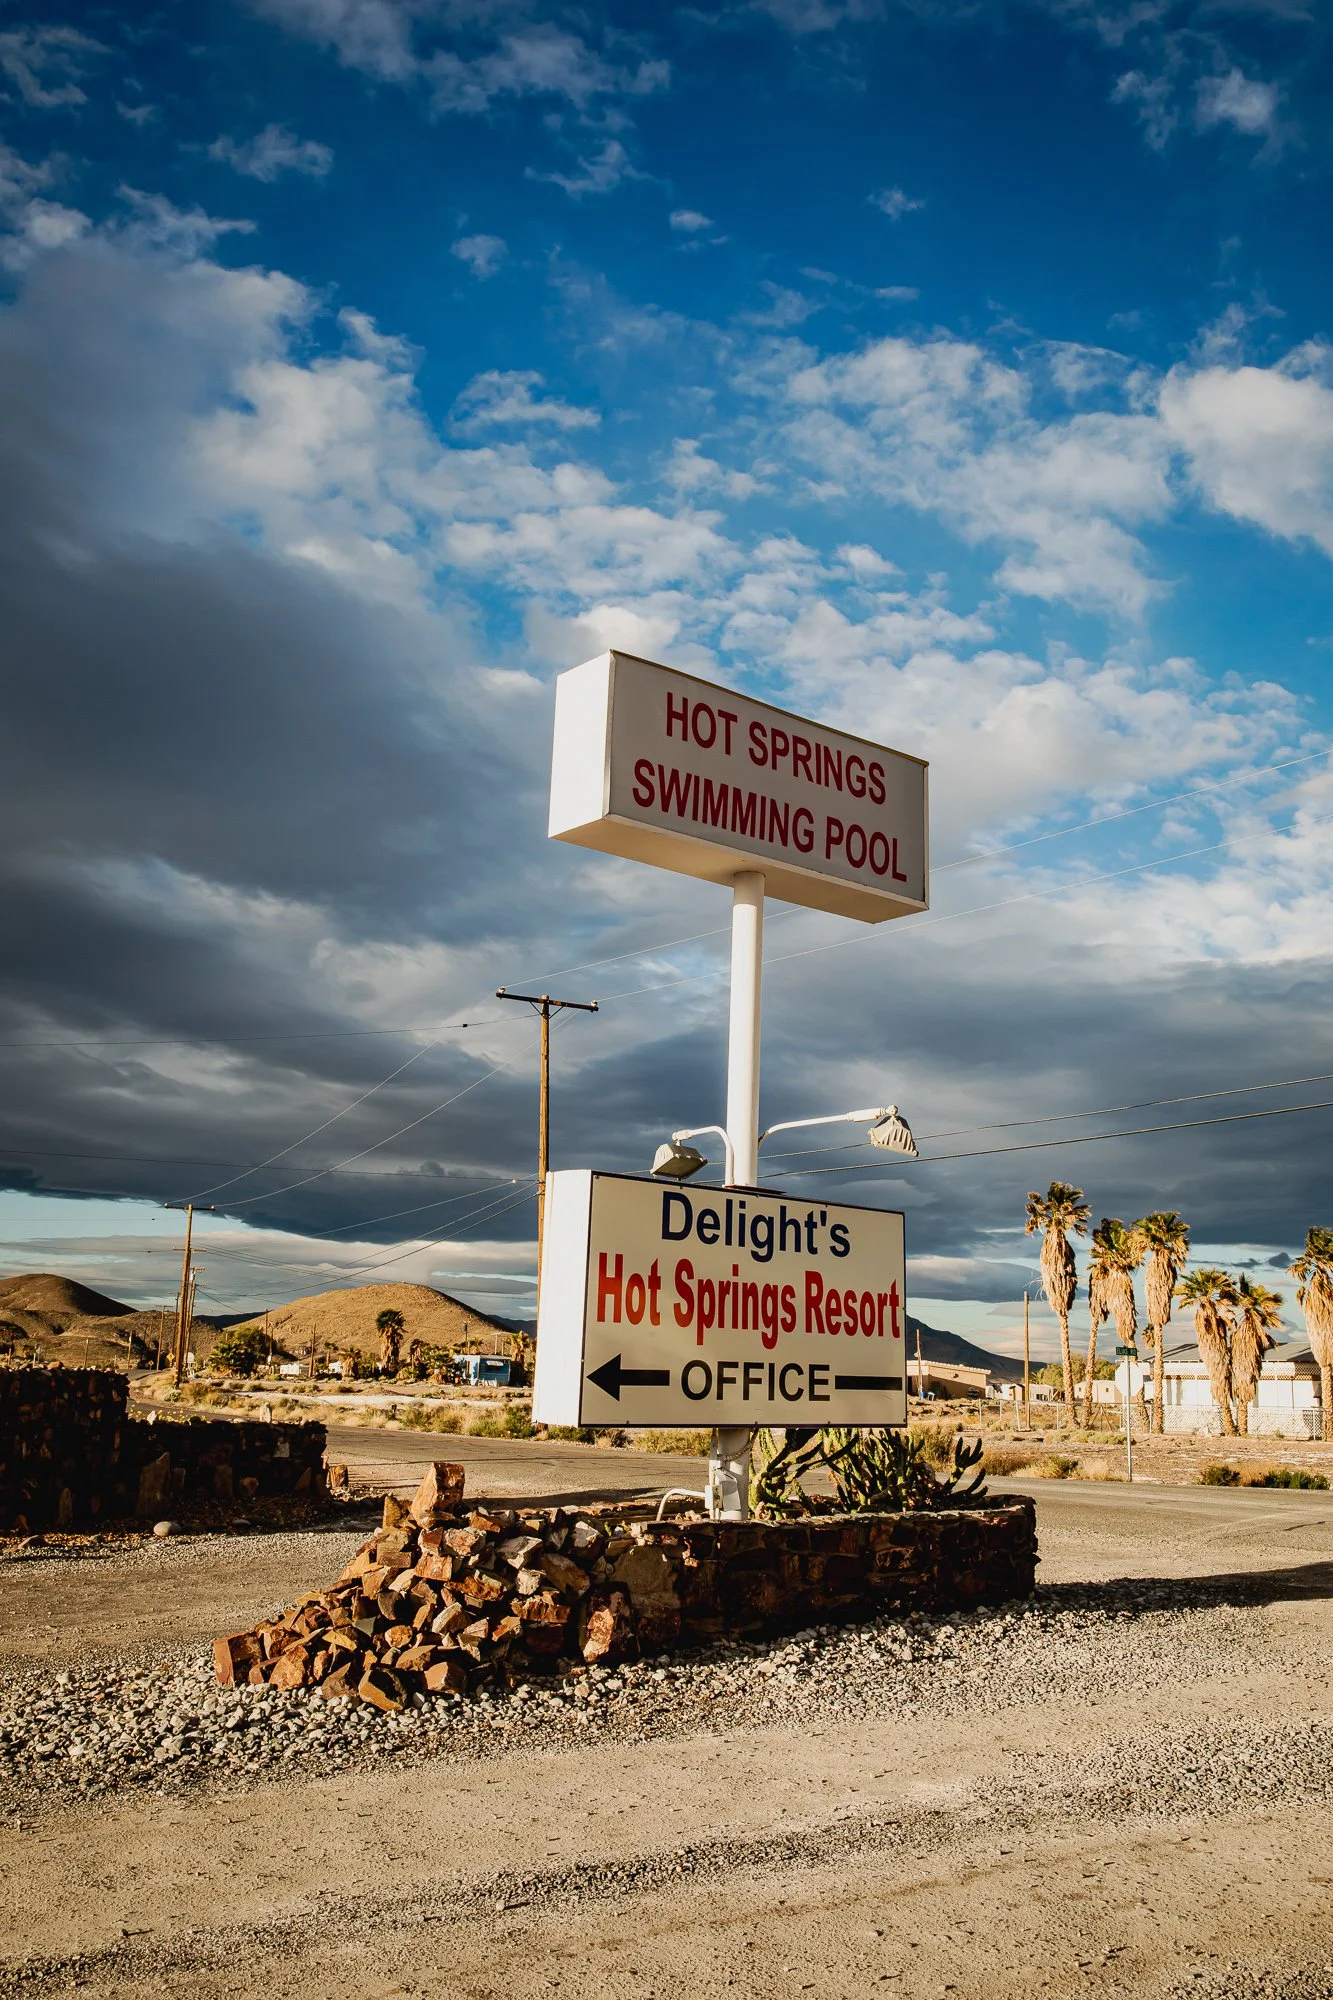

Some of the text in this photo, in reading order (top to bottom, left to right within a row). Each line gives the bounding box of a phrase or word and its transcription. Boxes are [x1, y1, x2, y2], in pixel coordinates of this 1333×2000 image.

[666, 692, 887, 805] HOT SPRINGS
[632, 758, 908, 883] SWIMMING POOL
[661, 1190, 850, 1263] Delight's
[597, 1252, 900, 1350] Hot Springs Resort
[680, 1359, 831, 1402] OFFICE
